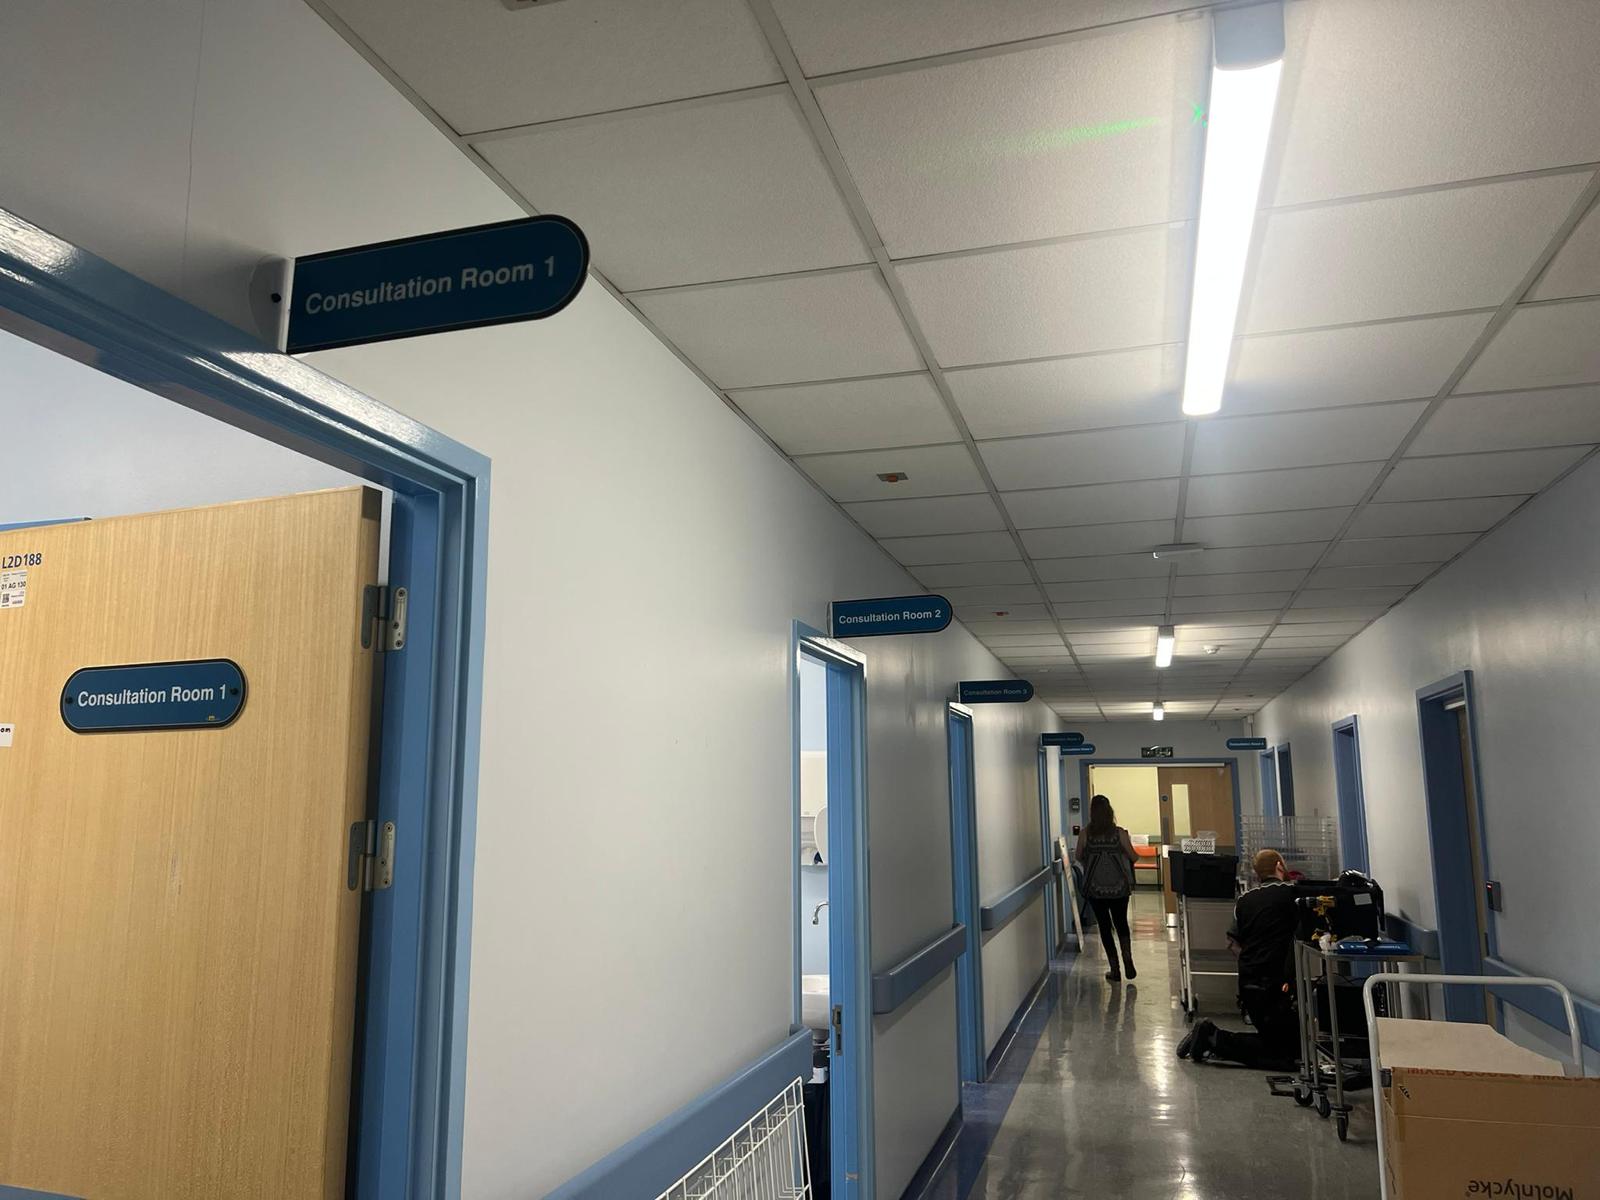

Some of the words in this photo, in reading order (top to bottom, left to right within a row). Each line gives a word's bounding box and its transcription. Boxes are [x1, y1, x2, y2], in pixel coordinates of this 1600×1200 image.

[305, 274, 452, 315] Consultation
[461, 262, 534, 290] Room
[544, 255, 555, 278] 1
[2, 553, 42, 569] L2D188
[838, 613, 900, 625] Consultation
[902, 610, 932, 620] Room
[934, 609, 941, 618] 2
[77, 688, 166, 707] Consultation
[171, 685, 214, 702] Room
[219, 684, 226, 699] 1
